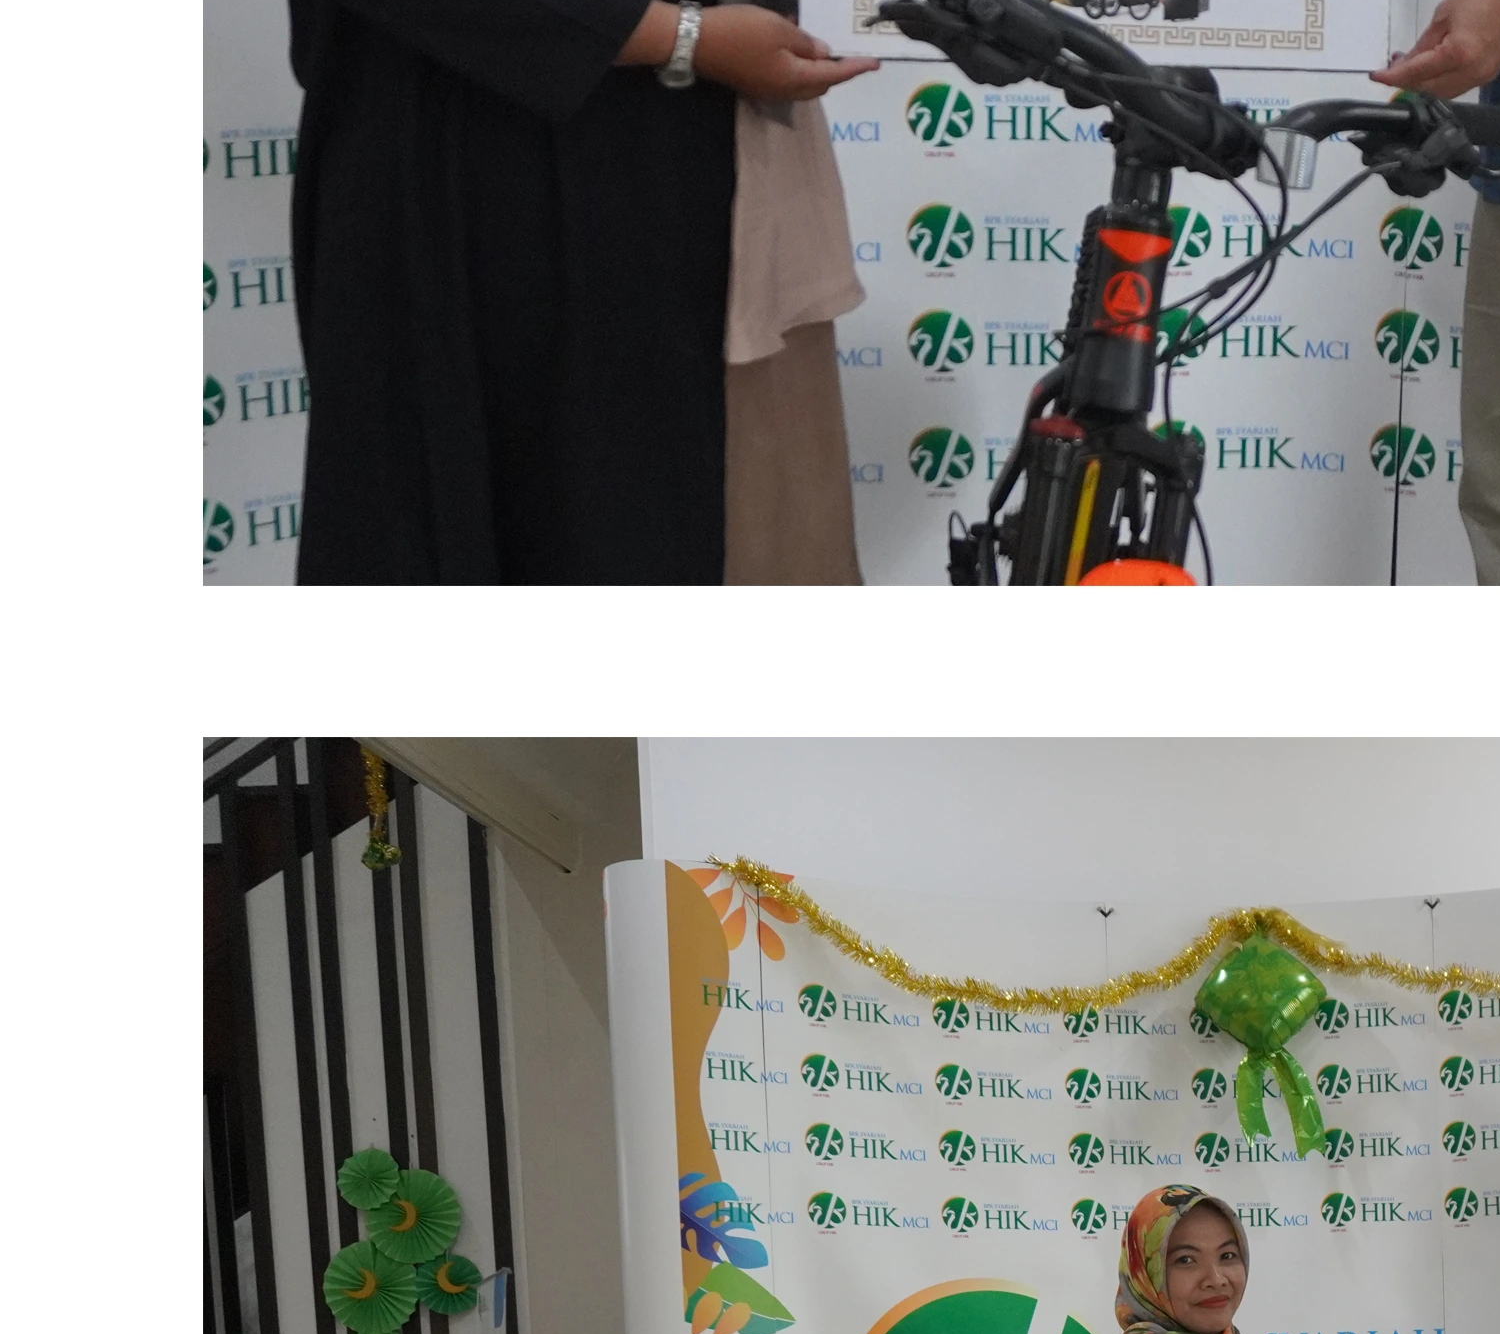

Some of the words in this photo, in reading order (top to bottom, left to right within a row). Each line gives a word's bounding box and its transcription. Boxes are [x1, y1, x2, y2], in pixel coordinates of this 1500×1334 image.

[986, 103, 1073, 142] HIK
[1220, 325, 1300, 358] HIK
[1304, 341, 1349, 359] MCI
[1218, 437, 1296, 469] HIK
[1301, 453, 1345, 470] MCI
[1355, 1007, 1398, 1028] HIK
[1401, 1016, 1425, 1025] MCI
[707, 1058, 757, 1083] HIK
[760, 1072, 788, 1084] MCI
[847, 1070, 893, 1092] HIK
[896, 1083, 922, 1094] MCI
[850, 1138, 897, 1160] HIK
[900, 1150, 926, 1161] MCI
